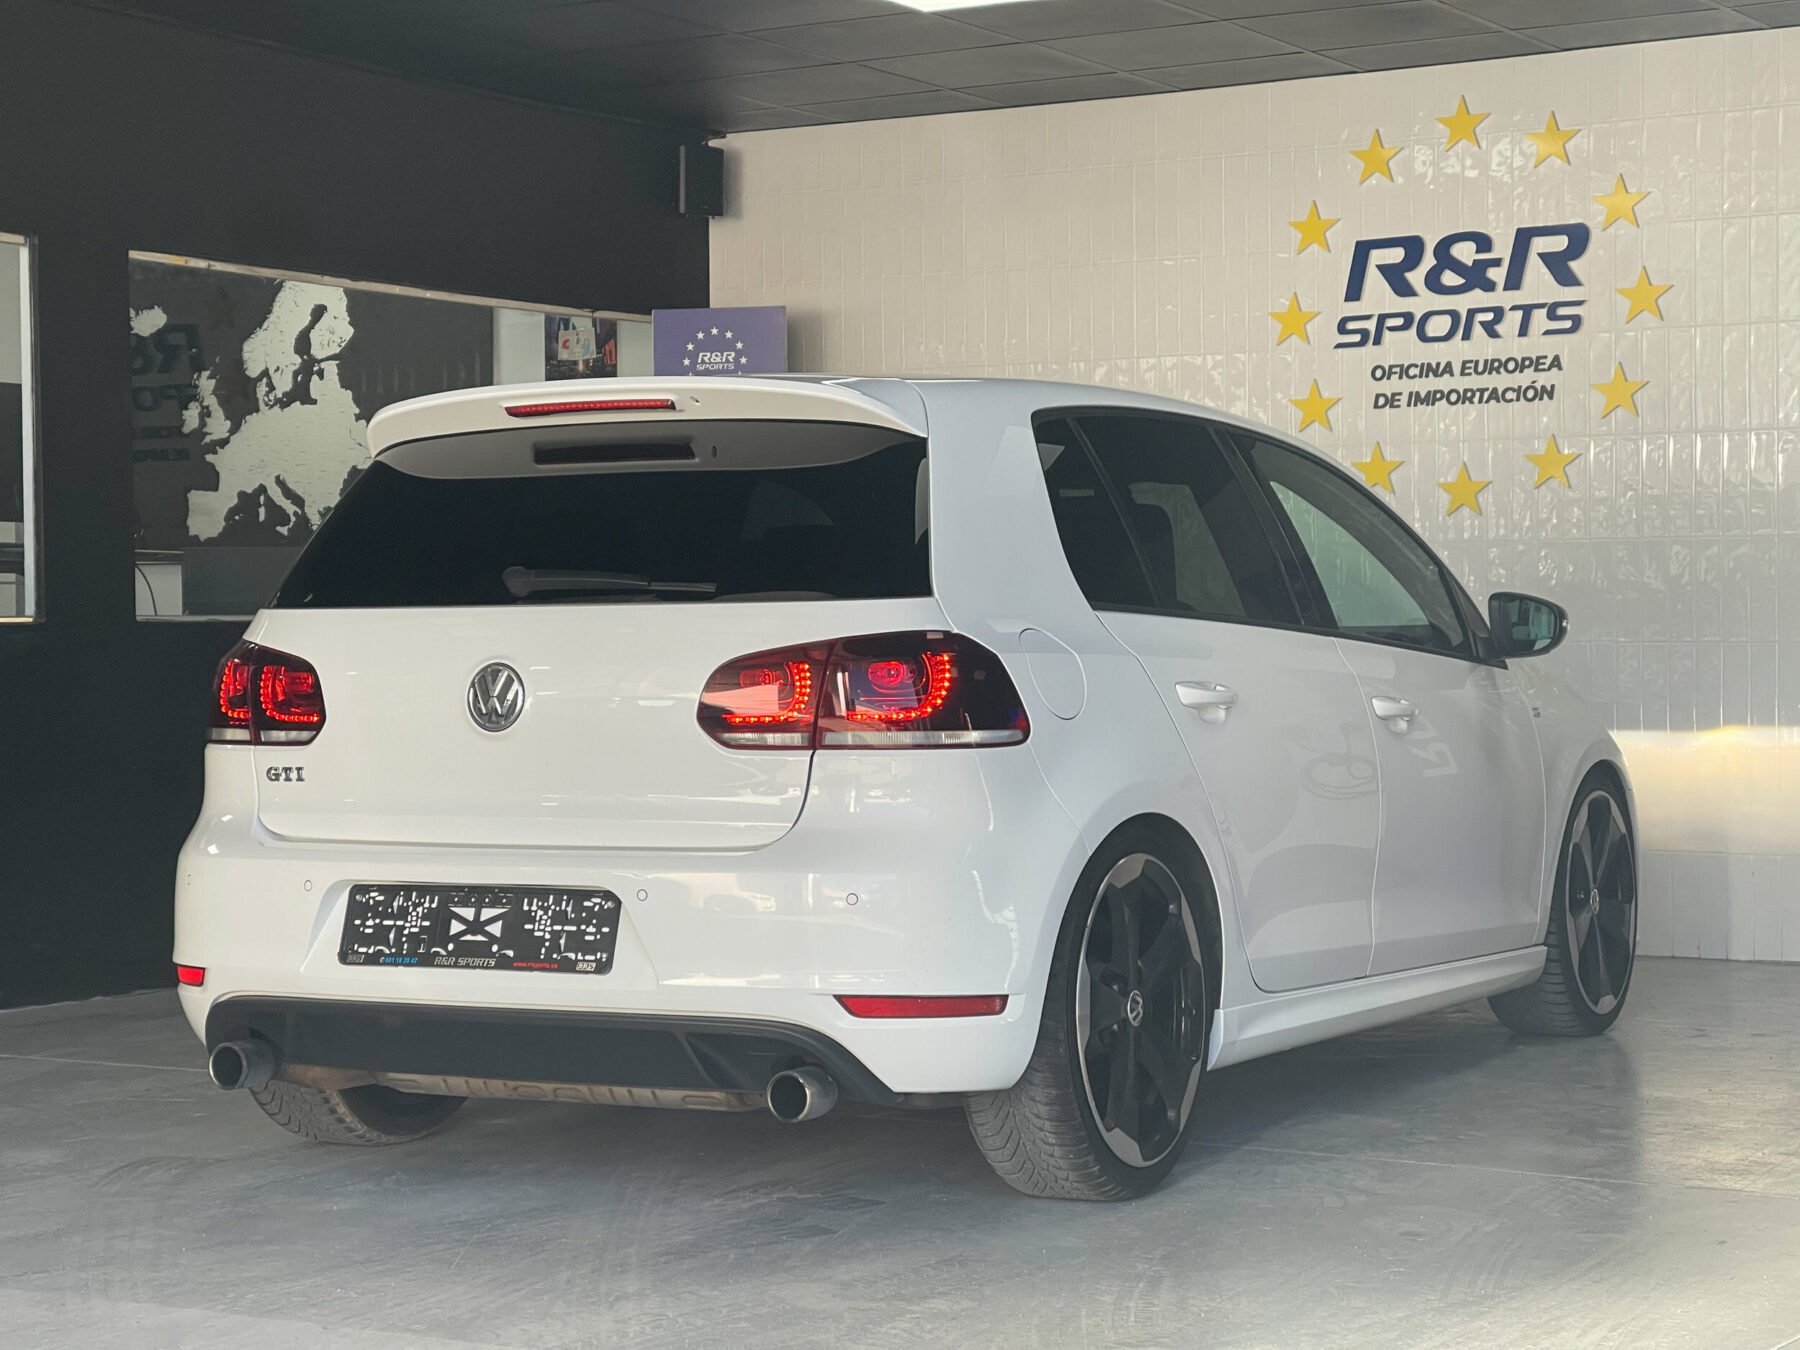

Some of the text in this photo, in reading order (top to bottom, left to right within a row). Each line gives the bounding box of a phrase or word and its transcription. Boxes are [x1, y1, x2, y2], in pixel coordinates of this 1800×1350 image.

[1344, 223, 1590, 302] R&R
[1333, 299, 1588, 349] SPORTS
[697, 352, 735, 363] R&R
[1371, 354, 1563, 381] OFICINA EUROPEA
[1373, 380, 1555, 409] DE IMPORTACIÓN
[266, 767, 305, 782] GTI
[434, 956, 496, 967] R&R SPORTS
